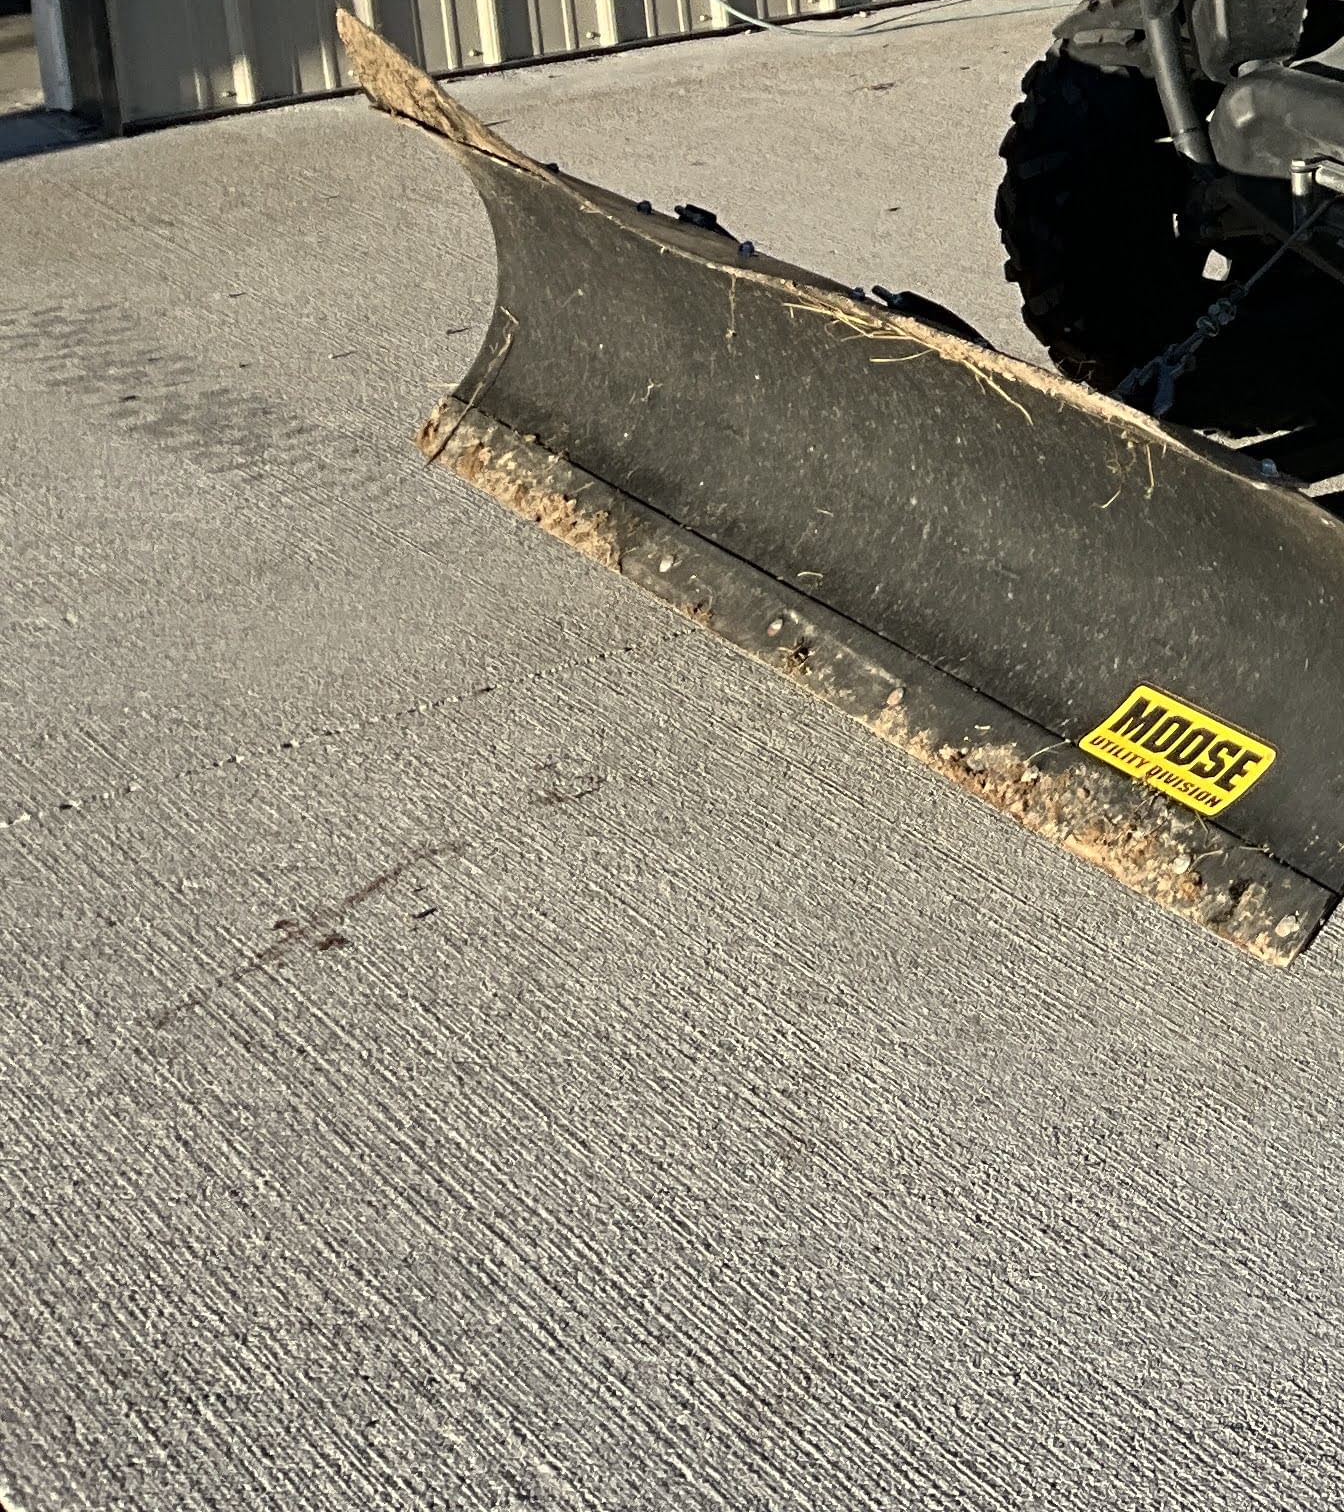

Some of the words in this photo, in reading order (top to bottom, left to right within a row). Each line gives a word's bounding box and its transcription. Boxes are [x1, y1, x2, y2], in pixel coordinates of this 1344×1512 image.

[1089, 735, 1149, 769] UTILITY
[1147, 764, 1222, 808] DIVISION
[1108, 696, 1263, 793] MOOSE
